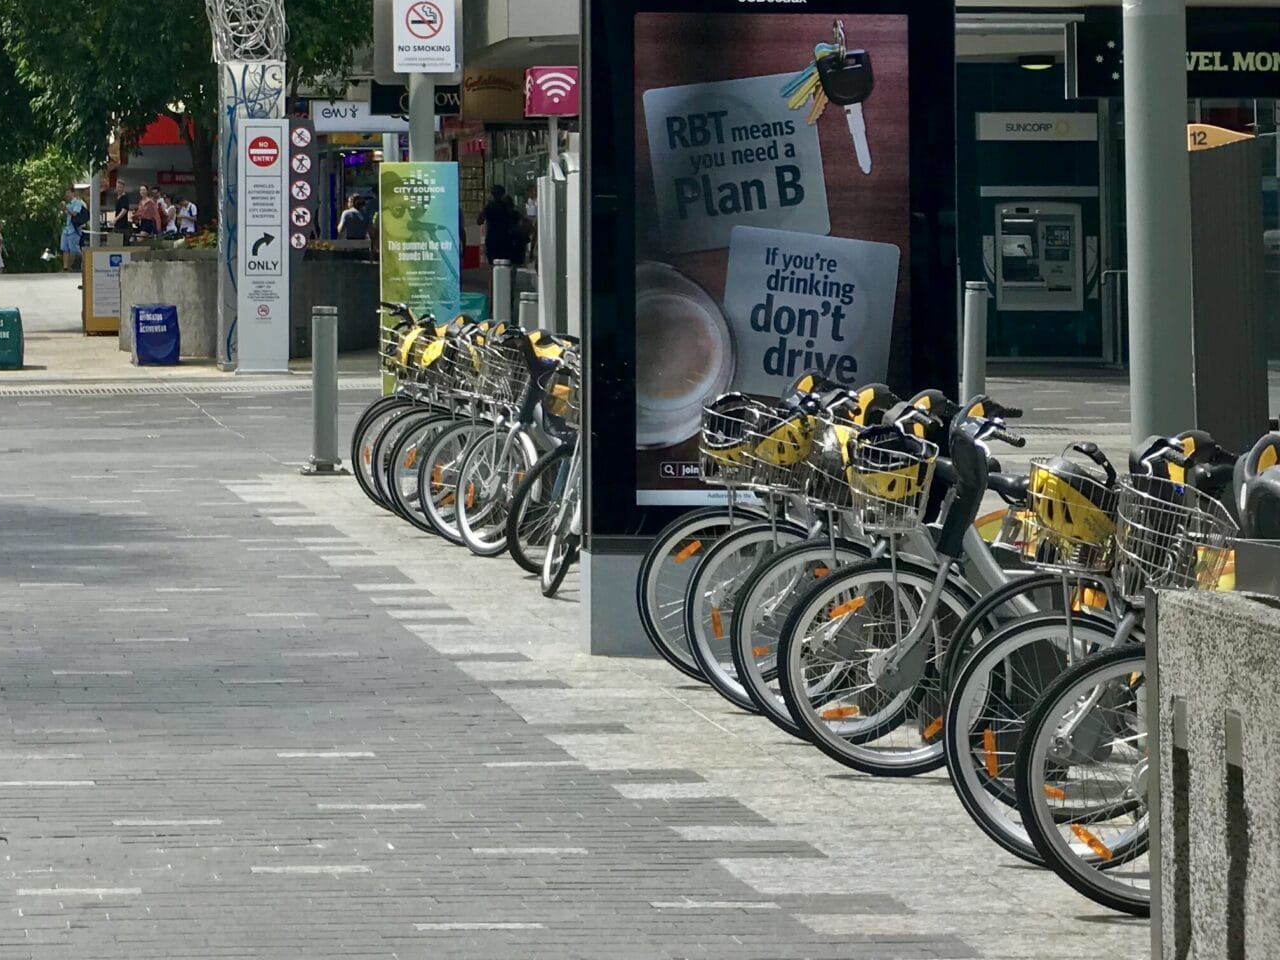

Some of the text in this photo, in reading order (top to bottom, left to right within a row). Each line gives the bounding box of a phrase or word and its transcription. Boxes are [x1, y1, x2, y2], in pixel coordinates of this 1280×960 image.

[666, 111, 796, 150] RBT means
[1005, 123, 1053, 133] SUNCORP
[1190, 131, 1208, 145] 12
[690, 140, 796, 175] you need a
[413, 186, 445, 194] SOUNDS
[674, 164, 805, 220] Plan B
[388, 241, 401, 251] This
[402, 241, 428, 251] summer
[398, 251, 421, 261] sounds
[247, 260, 279, 271] ONLY
[765, 247, 837, 273] If you're
[766, 269, 855, 305] drinking
[750, 293, 846, 342] don't
[762, 336, 858, 385] drive
[681, 465, 700, 475] join
